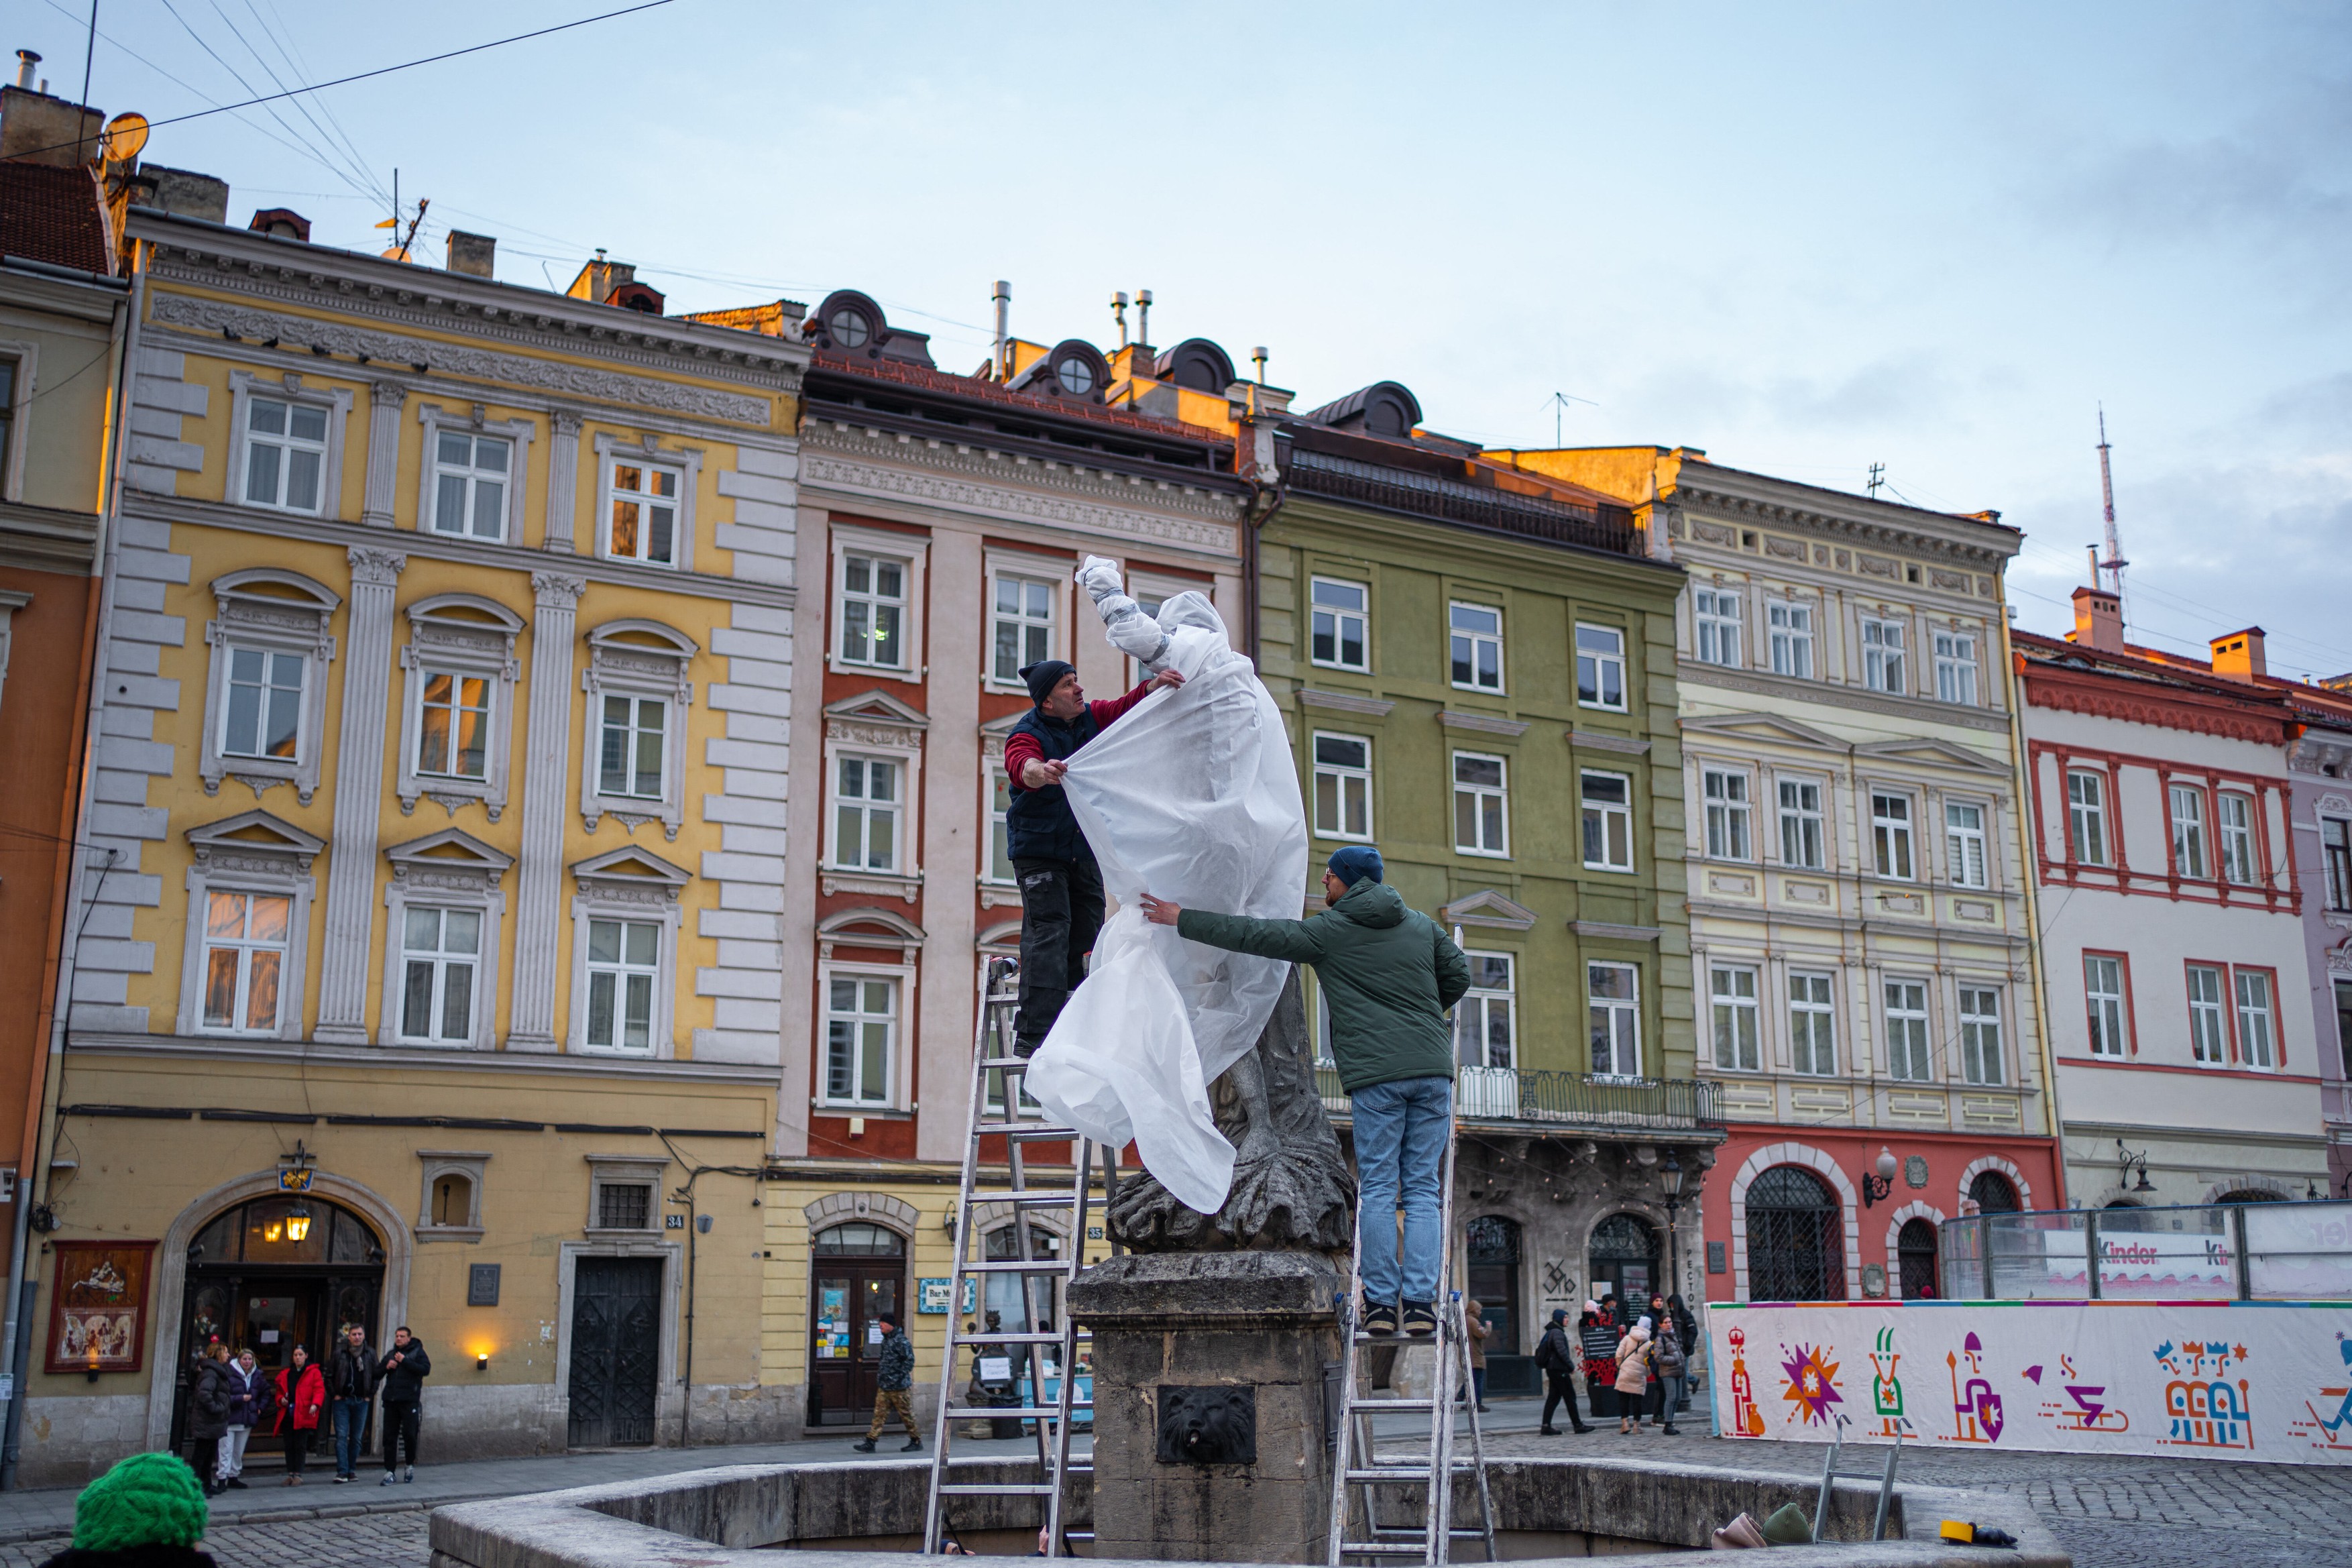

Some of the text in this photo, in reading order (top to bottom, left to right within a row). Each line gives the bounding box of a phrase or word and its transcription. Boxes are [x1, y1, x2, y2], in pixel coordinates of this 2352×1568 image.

[668, 1215, 683, 1228] 34
[1088, 1228, 1101, 1238] 35
[929, 1289, 942, 1298] Bar
